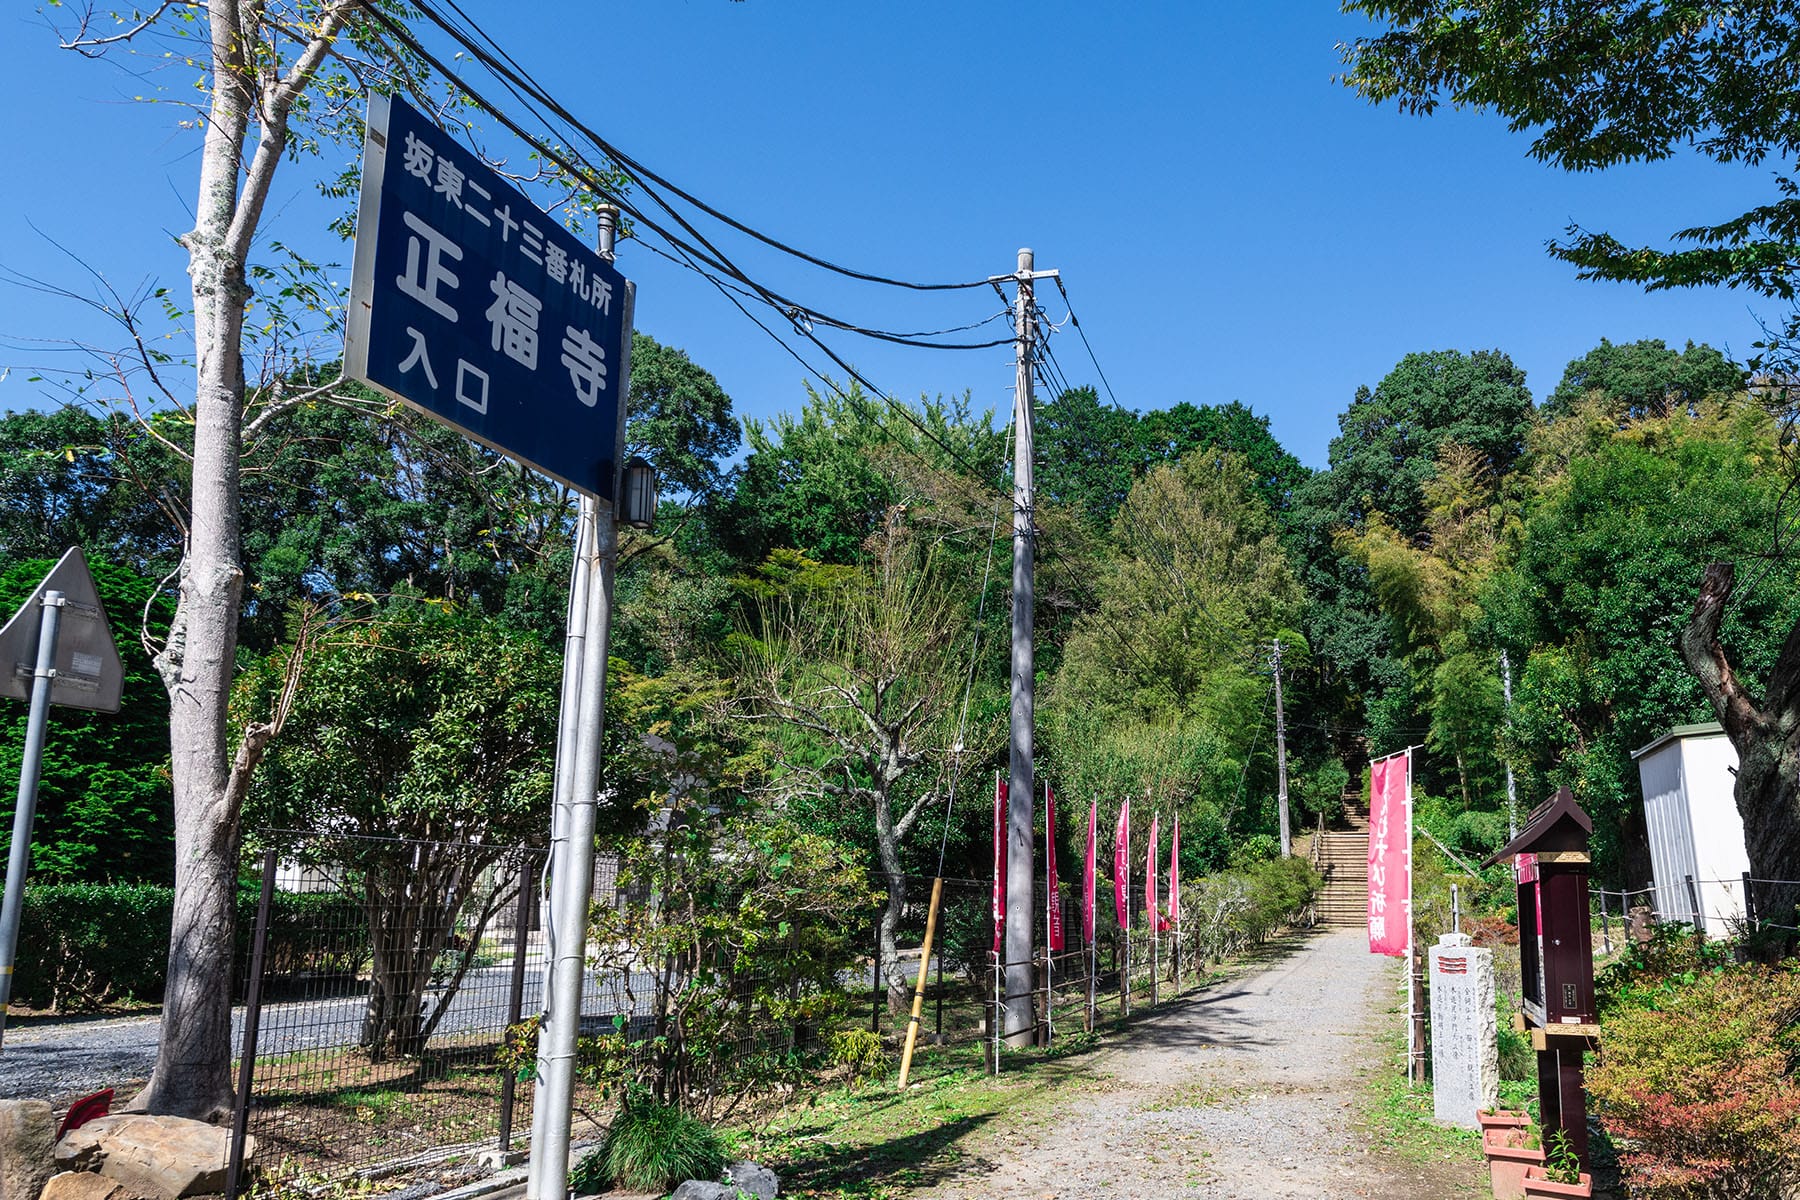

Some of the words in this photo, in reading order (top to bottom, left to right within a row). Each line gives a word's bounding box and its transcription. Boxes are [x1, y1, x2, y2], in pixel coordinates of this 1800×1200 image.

[395, 210, 607, 407] 正福寺
[404, 130, 613, 316] 坂東二十三番札所
[398, 325, 490, 415] 入口
